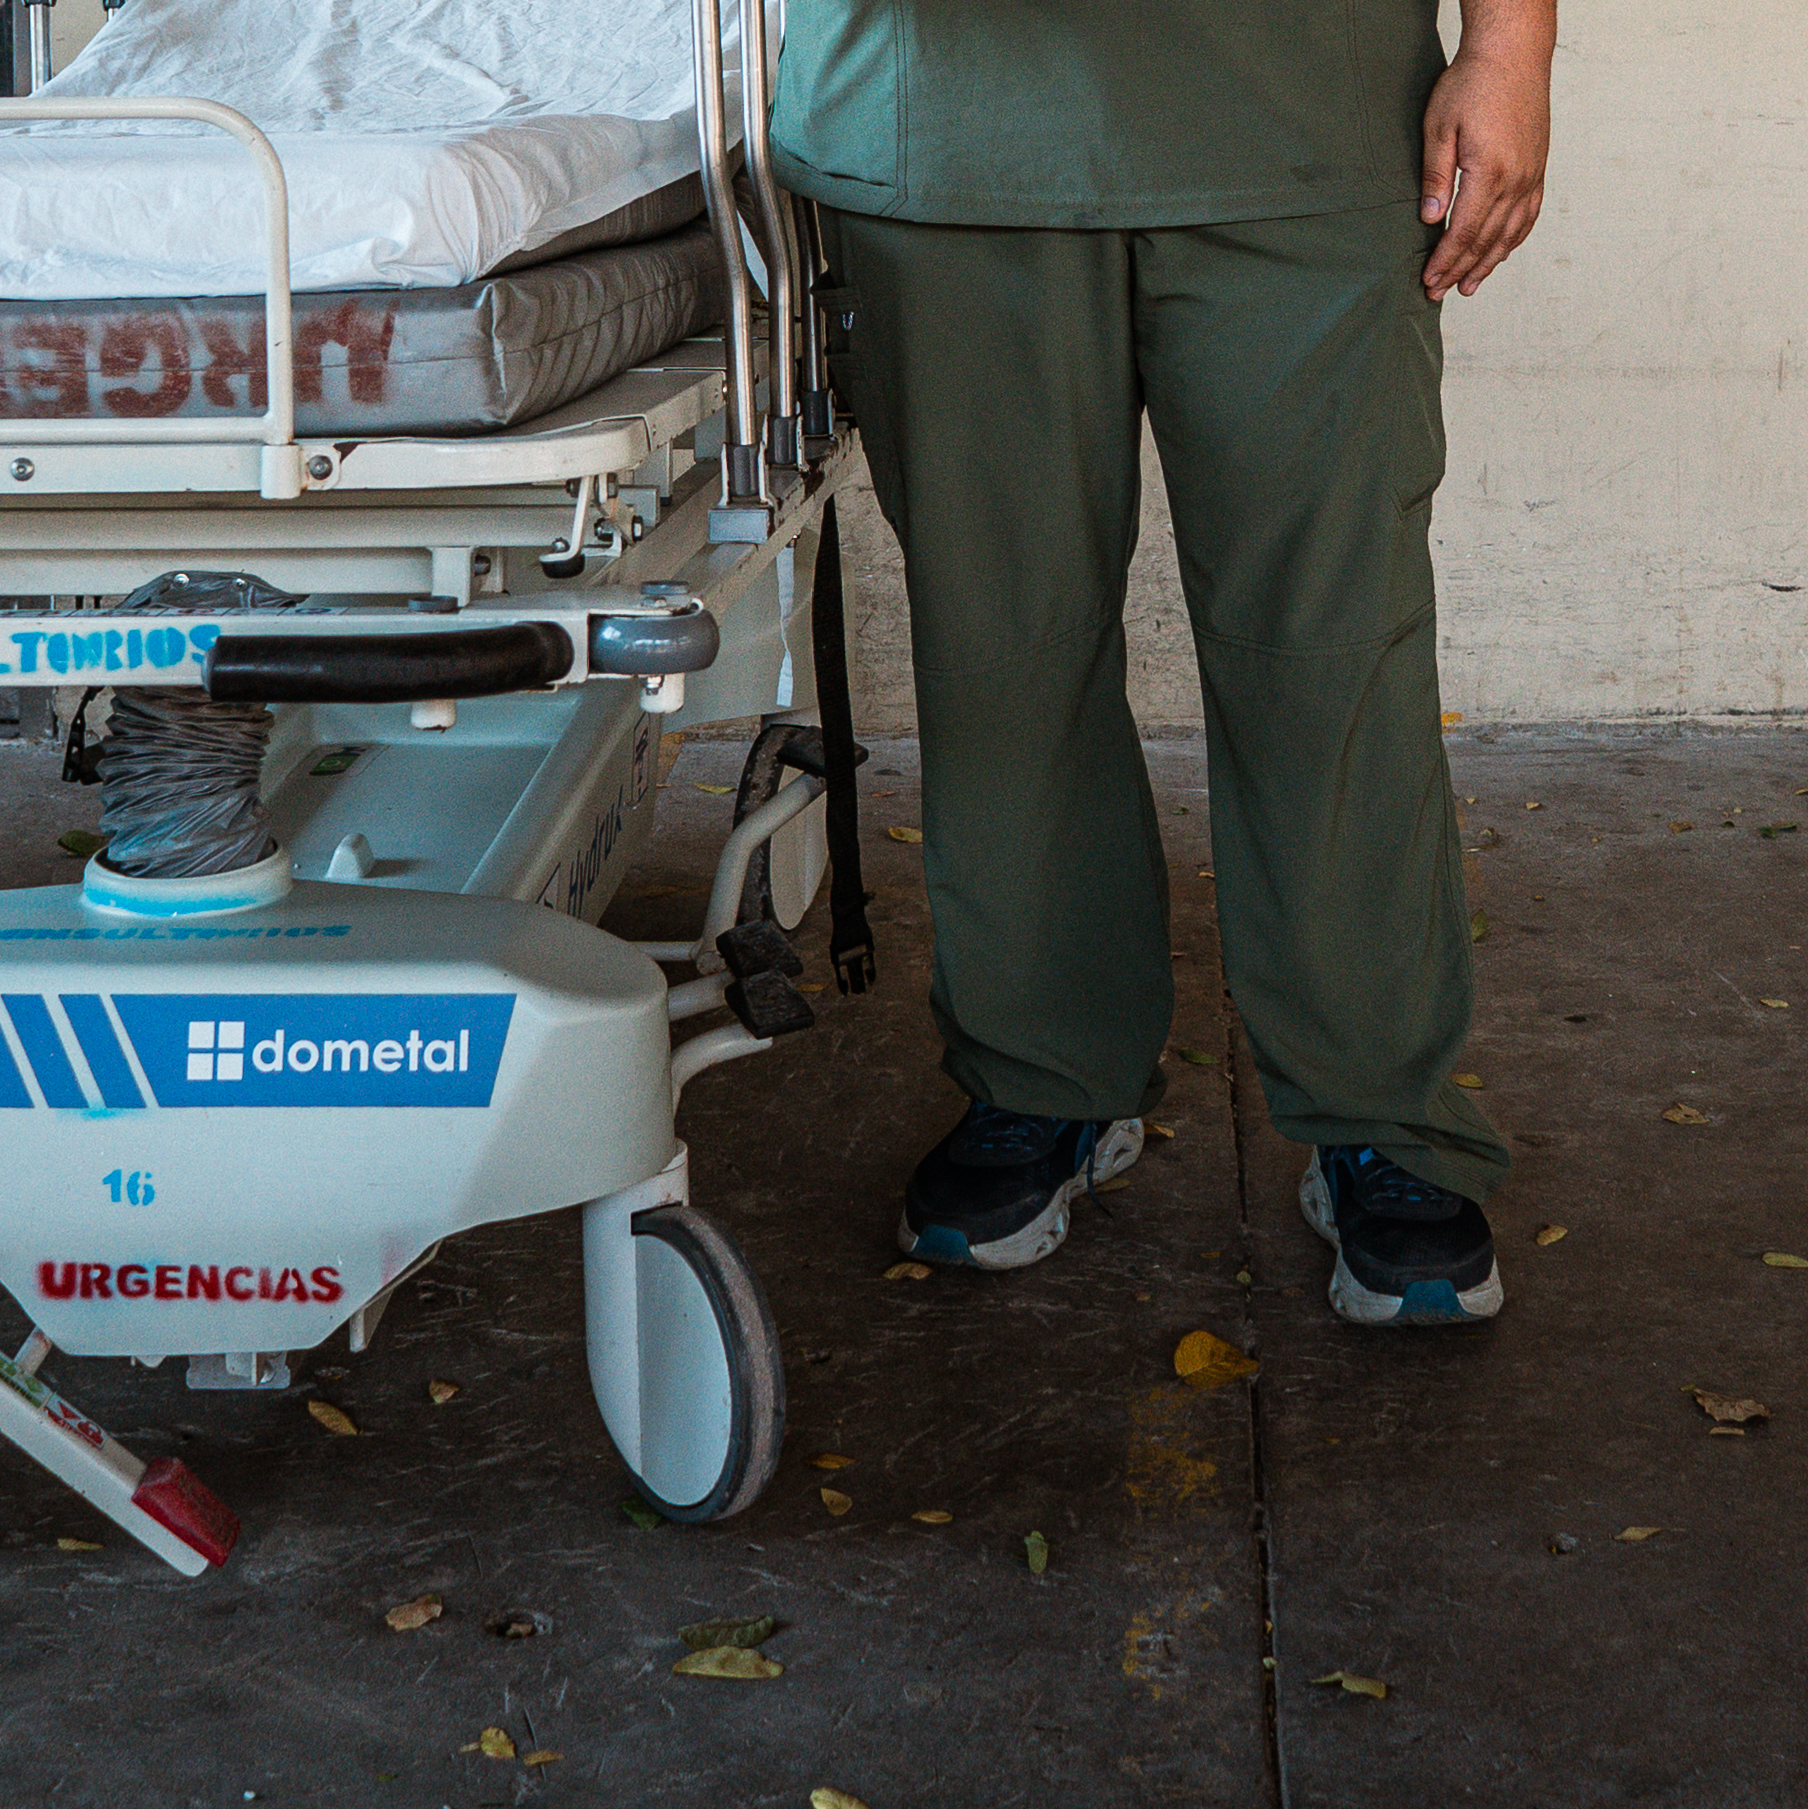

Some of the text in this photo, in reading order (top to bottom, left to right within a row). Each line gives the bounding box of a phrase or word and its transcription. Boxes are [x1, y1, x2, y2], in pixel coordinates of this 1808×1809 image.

[251, 1029, 469, 1073] dometal
[102, 1169, 156, 1206] 16
[35, 1260, 344, 1305] URGENCIAS
